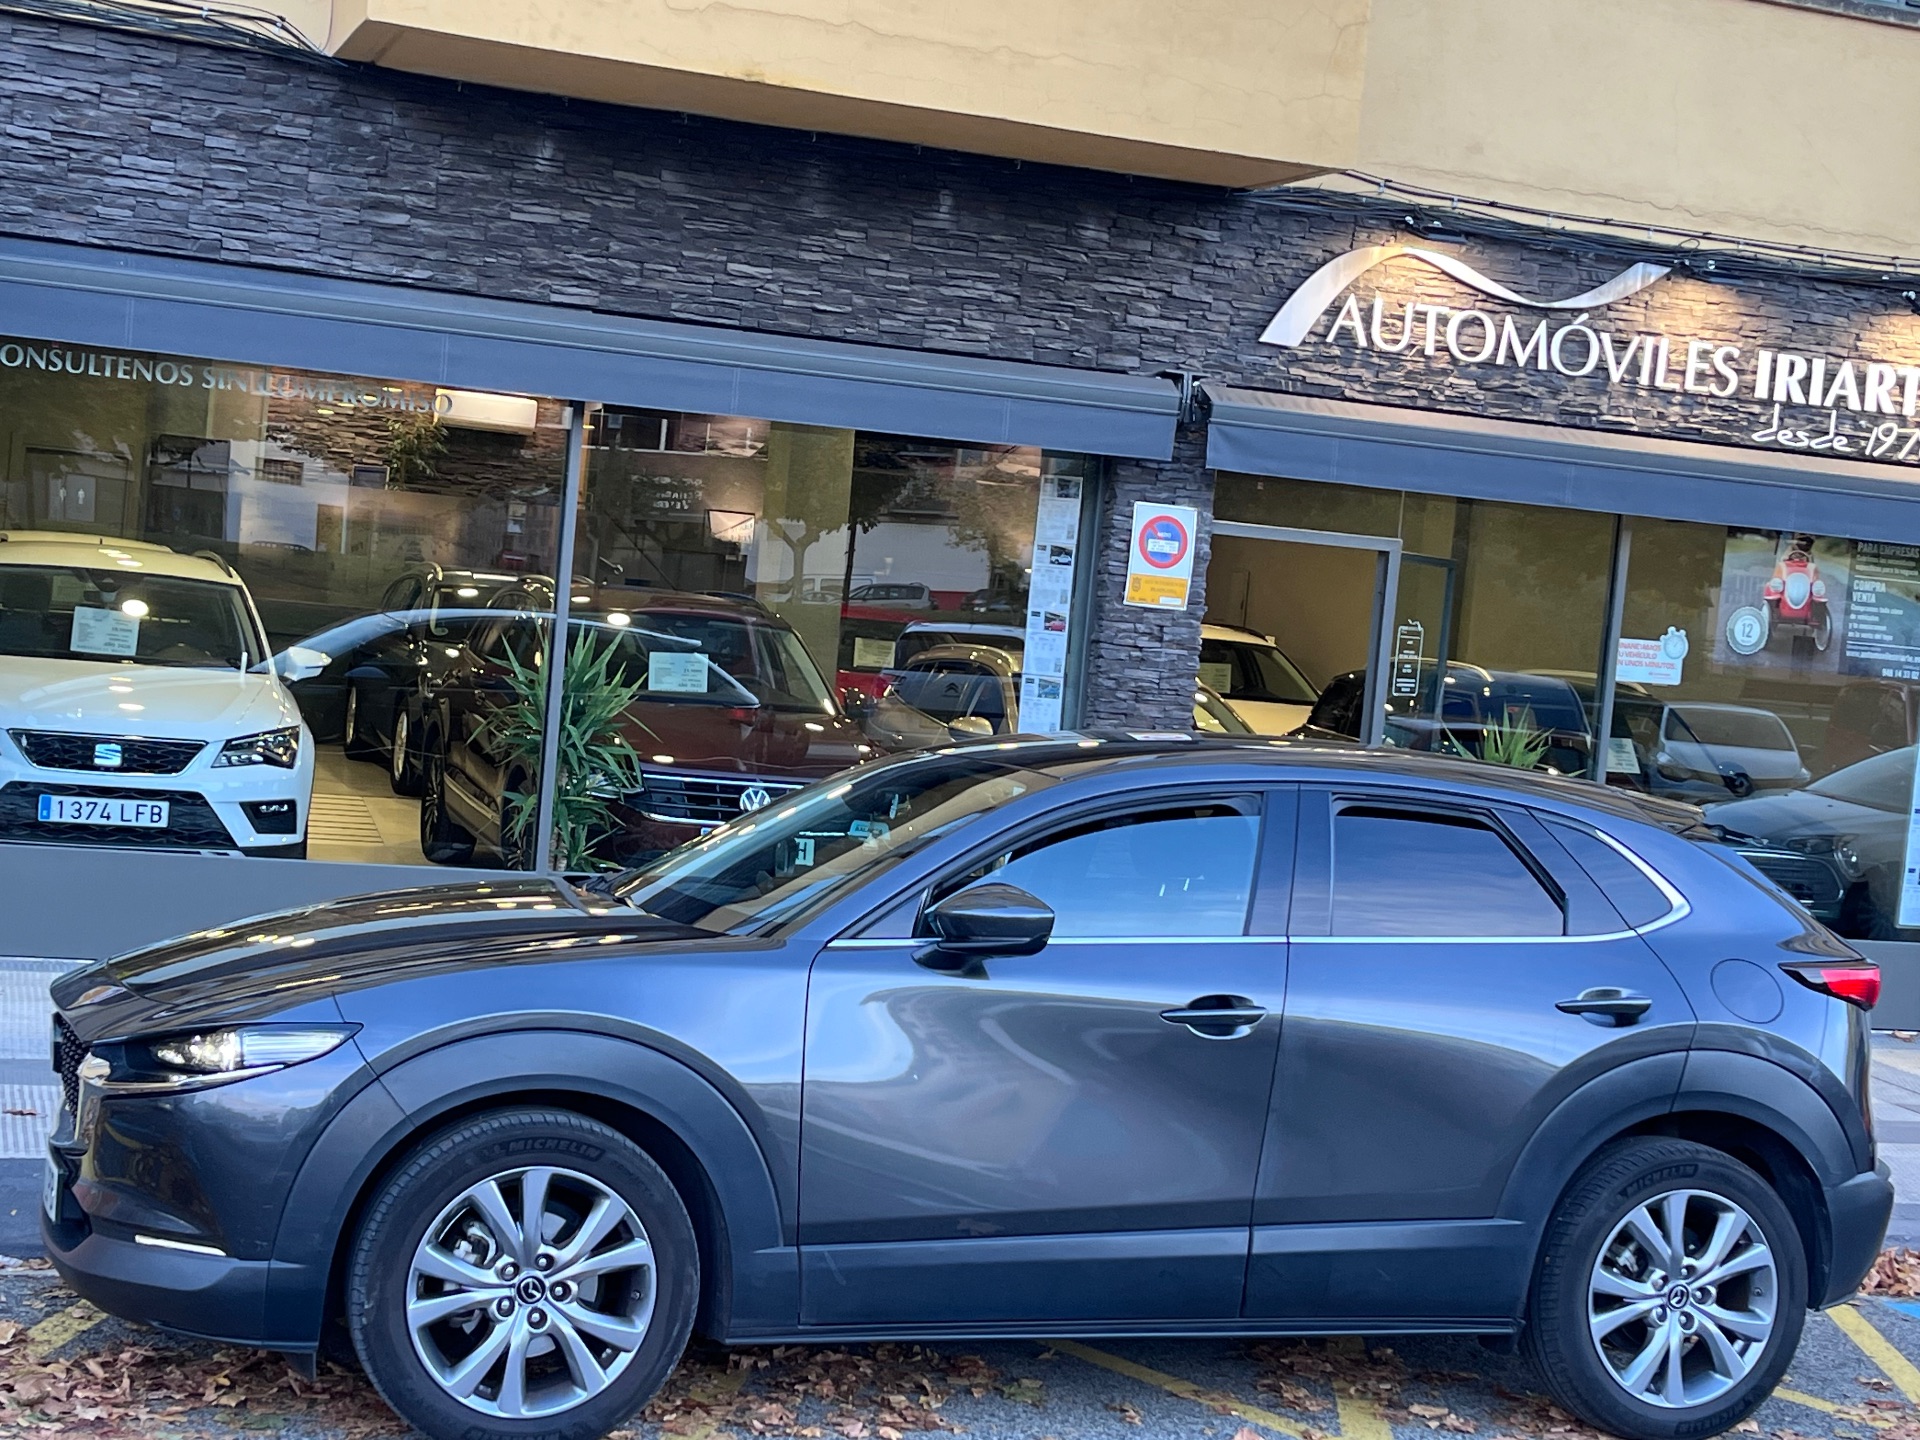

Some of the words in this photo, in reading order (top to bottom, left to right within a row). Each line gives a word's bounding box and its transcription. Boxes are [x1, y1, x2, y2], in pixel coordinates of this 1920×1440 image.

[1326, 293, 1740, 398] AUTOMÓVILES
[1754, 350, 1920, 416] IRIART
[202, 366, 247, 393] SIN
[257, 372, 453, 415] COMPROMISO
[1751, 402, 1853, 451] desde
[1865, 422, 1920, 460] 197
[1852, 591, 1876, 603] VENTA
[1853, 579, 1887, 593] COMPRA
[1741, 622, 1754, 638] 12
[56, 799, 112, 822] 1374
[120, 803, 163, 824] LFB
[508, 1138, 600, 1160] MICHELIN
